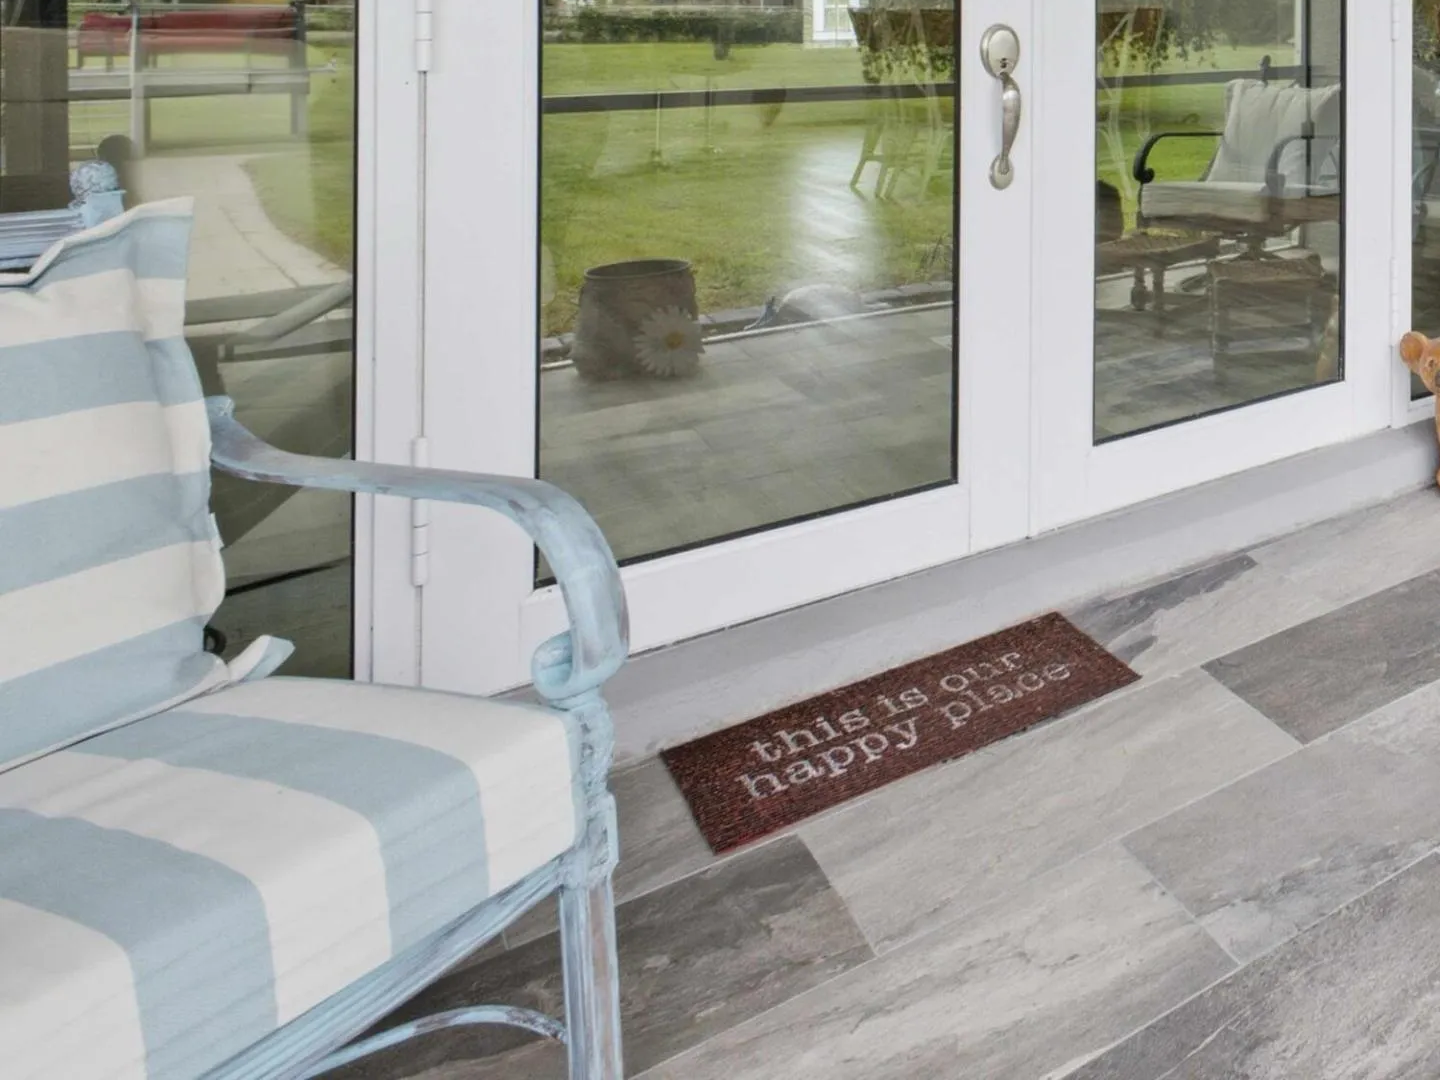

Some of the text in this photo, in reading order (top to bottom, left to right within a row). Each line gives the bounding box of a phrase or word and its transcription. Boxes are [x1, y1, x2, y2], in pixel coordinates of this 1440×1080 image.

[736, 662, 1073, 801] happy place
[749, 651, 1022, 763] this is our
